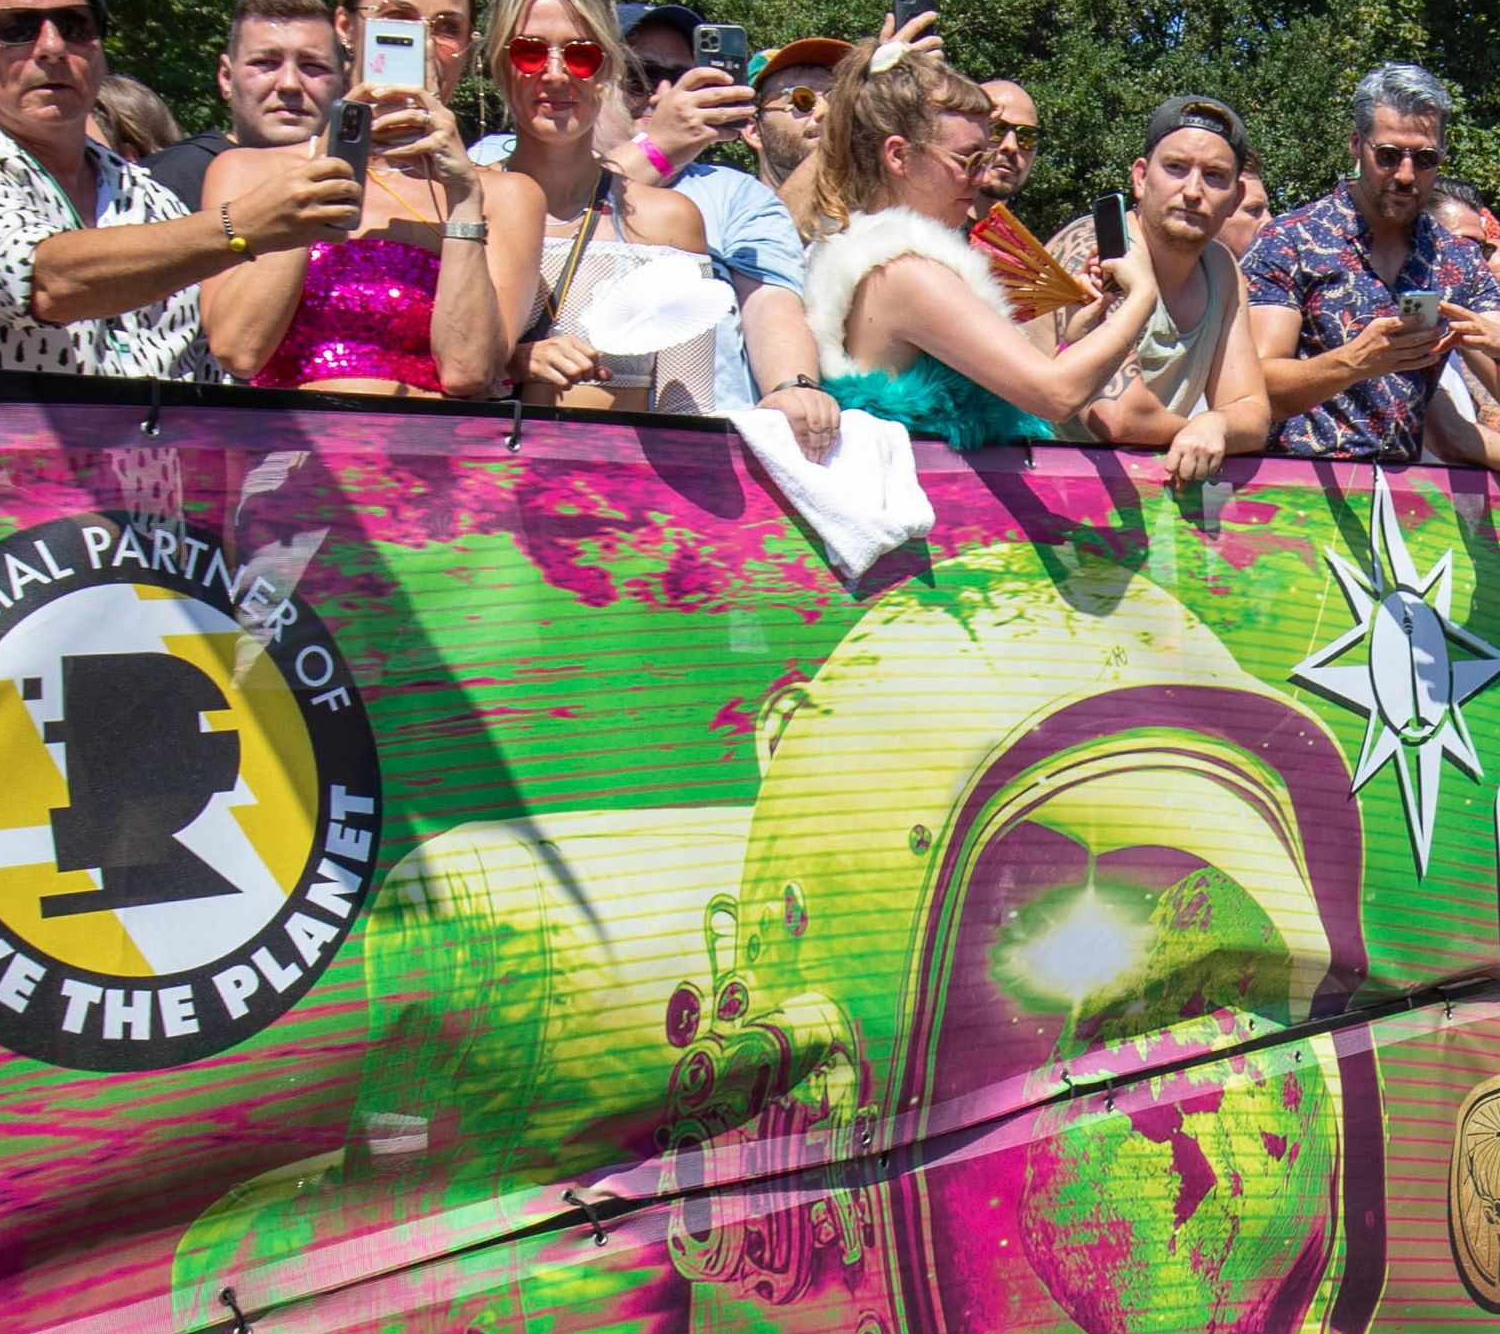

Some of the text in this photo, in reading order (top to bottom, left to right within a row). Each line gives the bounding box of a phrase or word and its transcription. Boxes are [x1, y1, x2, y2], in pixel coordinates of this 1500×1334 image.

[81, 524, 299, 644] PARTNER
[295, 644, 352, 712] OF
[59, 980, 200, 1041] THE
[212, 784, 376, 1020] PLANET
